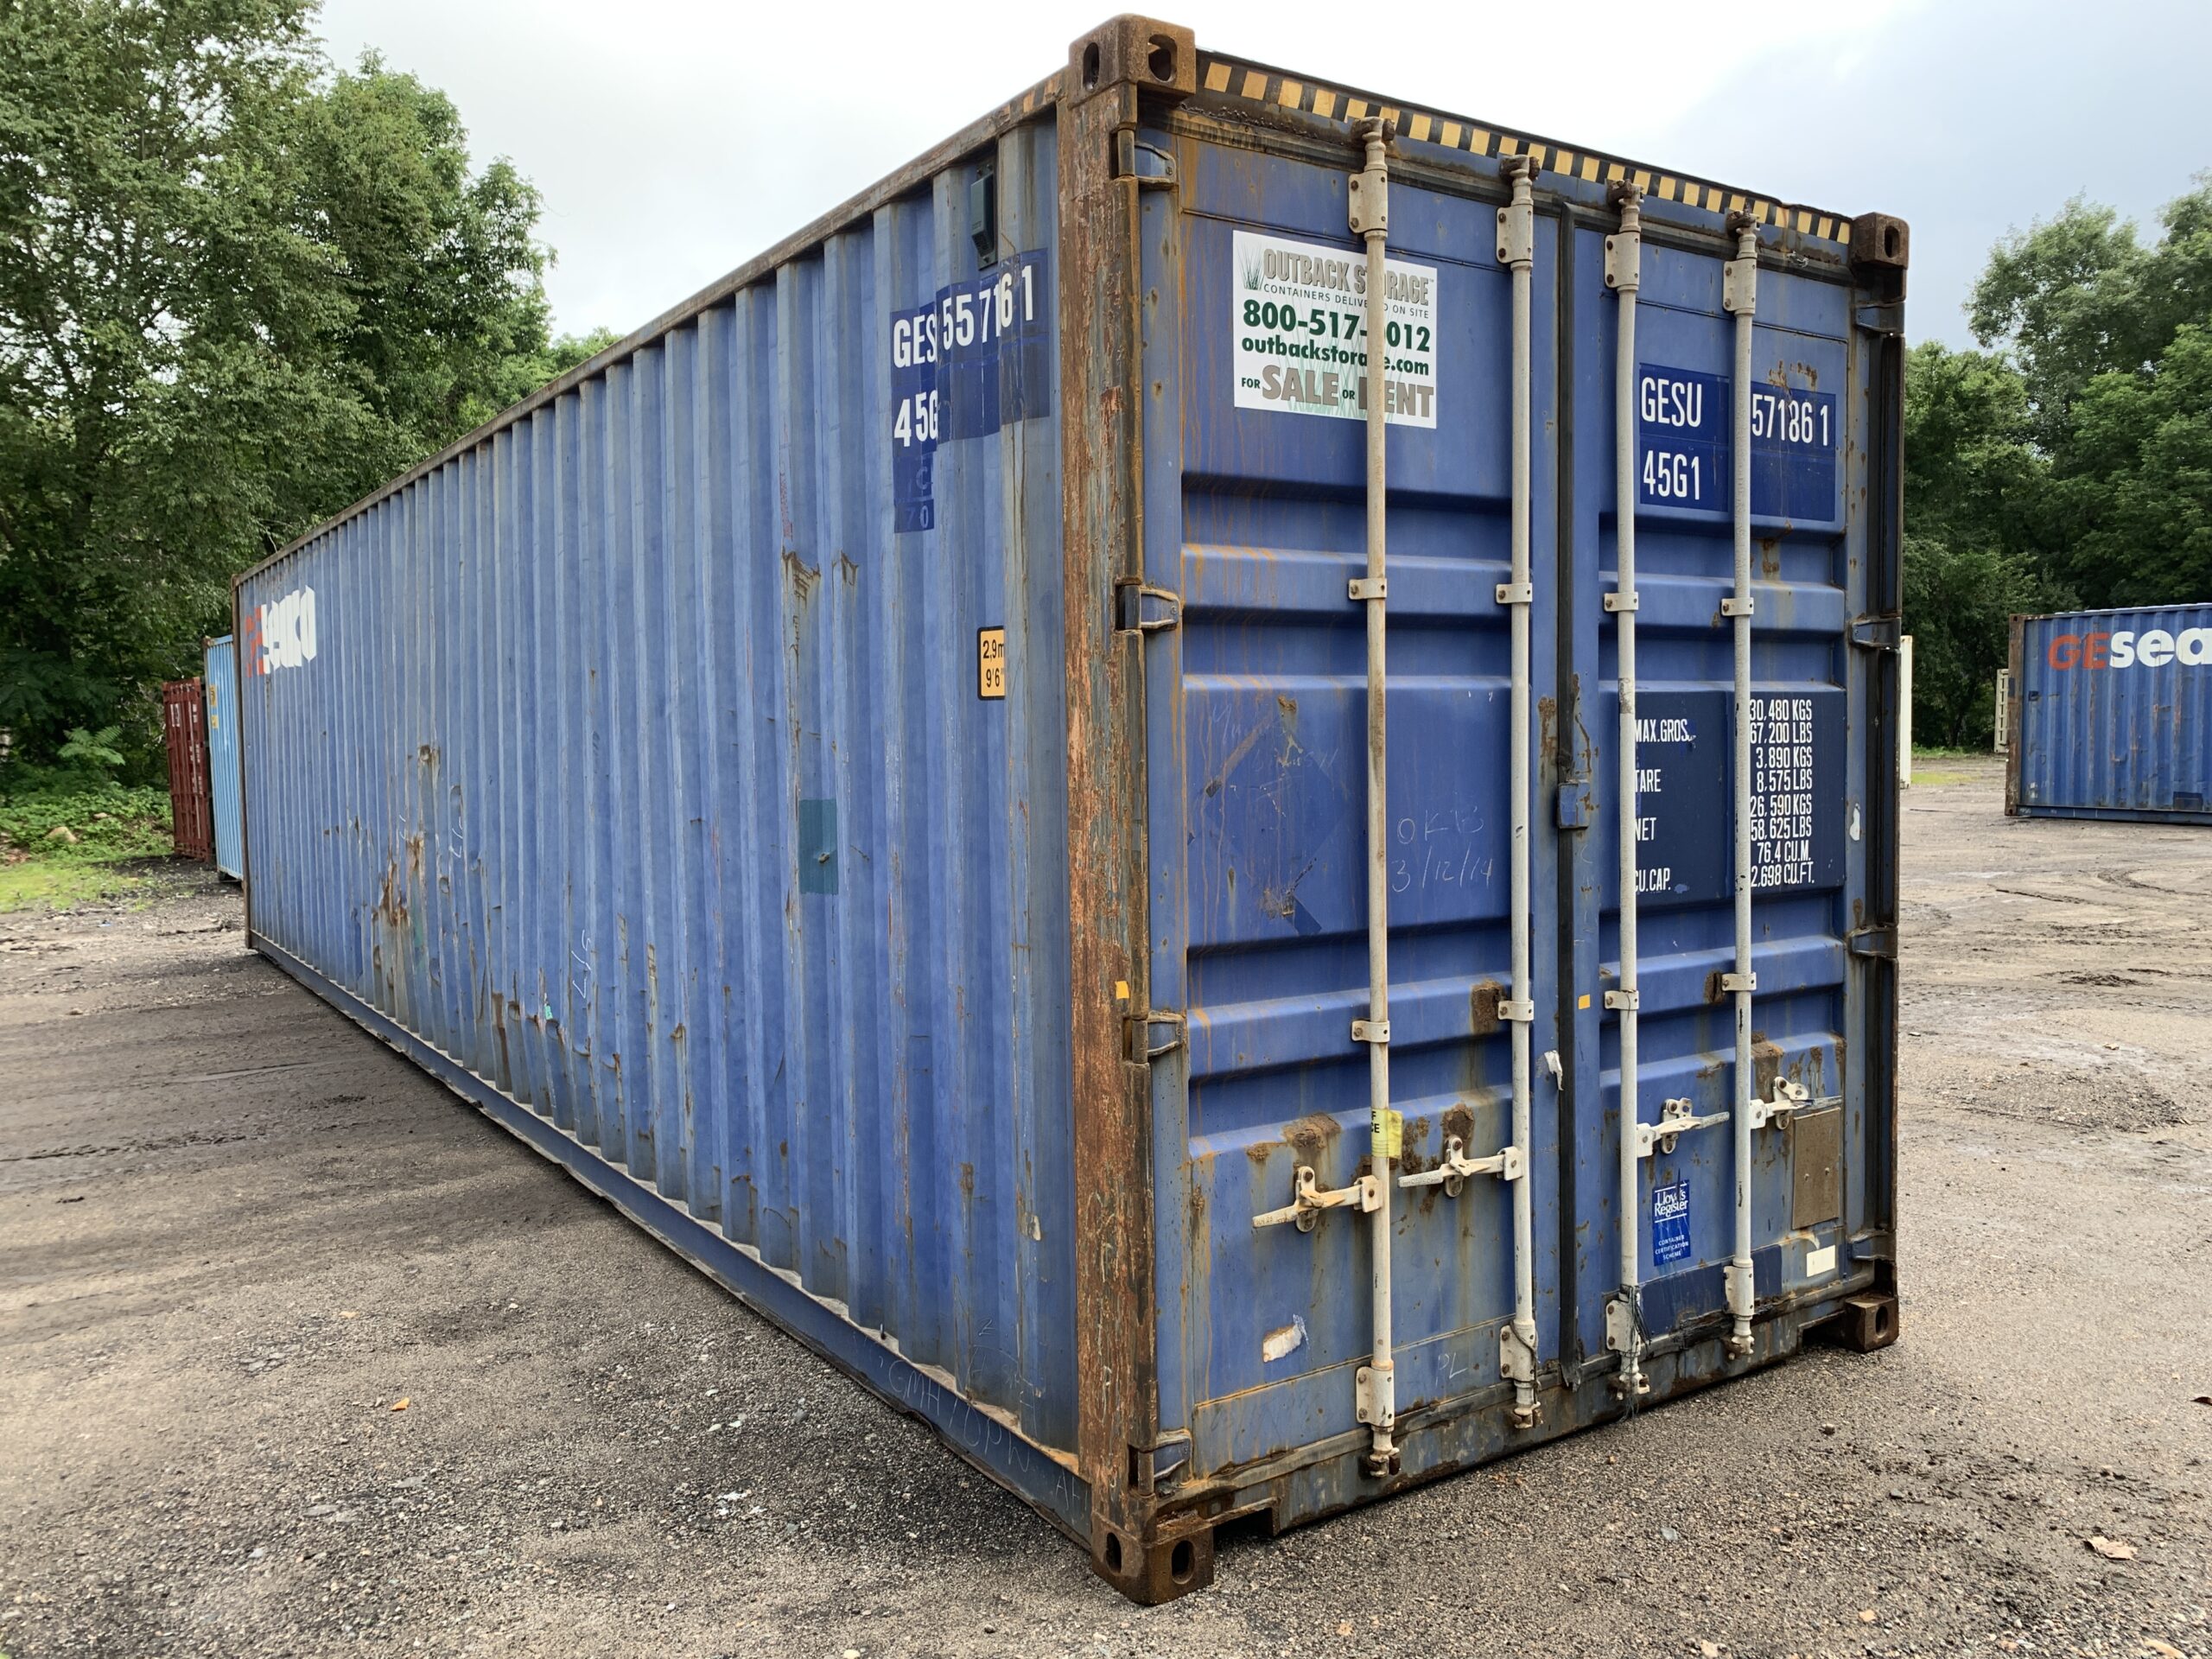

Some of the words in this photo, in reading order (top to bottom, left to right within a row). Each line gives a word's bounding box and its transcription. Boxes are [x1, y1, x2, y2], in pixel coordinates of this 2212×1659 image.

[1263, 249, 1351, 292] OUTBACK
[1354, 264, 1429, 306] SRAGE
[1263, 283, 1331, 302] CONTAINERS
[1335, 295, 1389, 311] DELIVED
[1392, 304, 1406, 315] ON
[1409, 308, 1429, 319] SITE
[1243, 299, 1431, 353] 800-517-012
[1242, 334, 1429, 376] outbackstorae.com
[1242, 378, 1261, 389] FOR
[1262, 365, 1338, 406] SALE
[1342, 389, 1355, 400] OR
[1641, 377, 1702, 428] GESU
[1643, 450, 1700, 500] 45G1
[1750, 699, 1789, 721] 30,480
[1792, 699, 1812, 721] KGS
[1750, 721, 1789, 744] 67,200
[1793, 721, 1813, 743] LBS
[1756, 747, 1790, 769] 3,890
[1793, 746, 1813, 768] KGS
[1635, 768, 1662, 793] TARE
[1757, 769, 1790, 793] 8,575
[1793, 768, 1813, 791] LBS
[1750, 794, 1791, 817] 26,590
[1792, 793, 1812, 816] KGS
[1635, 817, 1656, 842] NET
[1751, 817, 1790, 842] 58,625
[1792, 816, 1812, 838] LBS
[1757, 840, 1781, 864] 76.4
[1784, 839, 1811, 862] CU.M.
[1751, 864, 1782, 888] 2,698
[1783, 861, 1815, 885] CU.FT.
[1654, 1199, 1688, 1218] Register
[1655, 1241, 1689, 1255] CERTIFICATION
[1662, 1250, 1681, 1261] SCHEME
